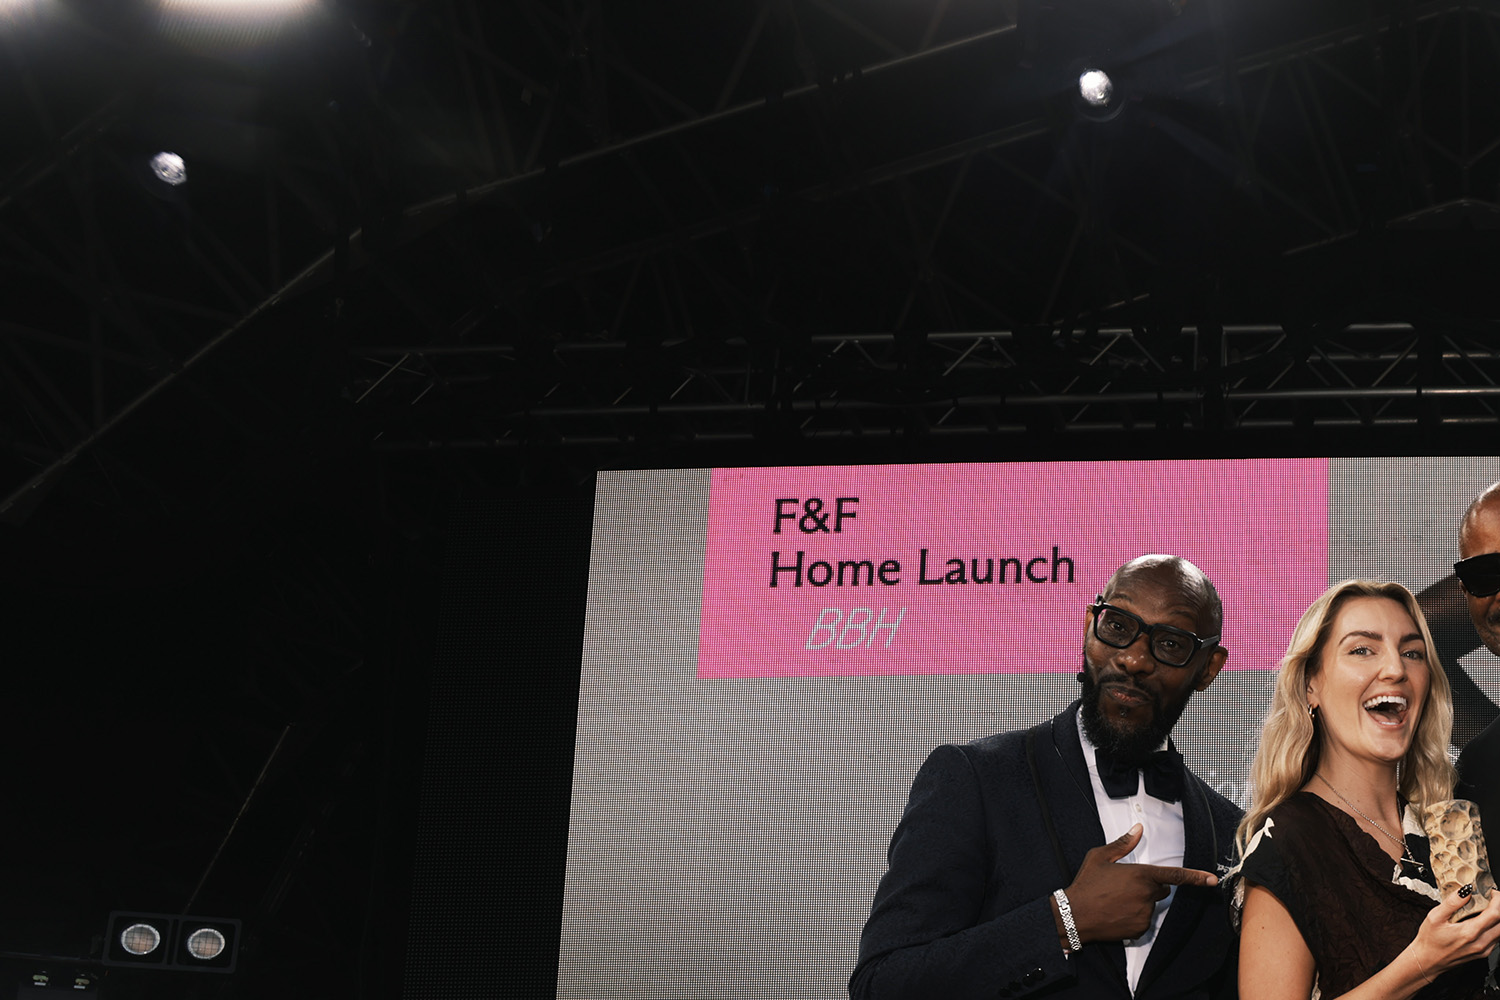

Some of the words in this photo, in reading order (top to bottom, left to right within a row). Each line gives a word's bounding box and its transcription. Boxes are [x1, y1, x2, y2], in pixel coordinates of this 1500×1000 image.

[773, 497, 860, 534] F&F
[769, 551, 901, 588] Home
[918, 546, 1075, 585] Launch
[804, 607, 907, 650] BBH
